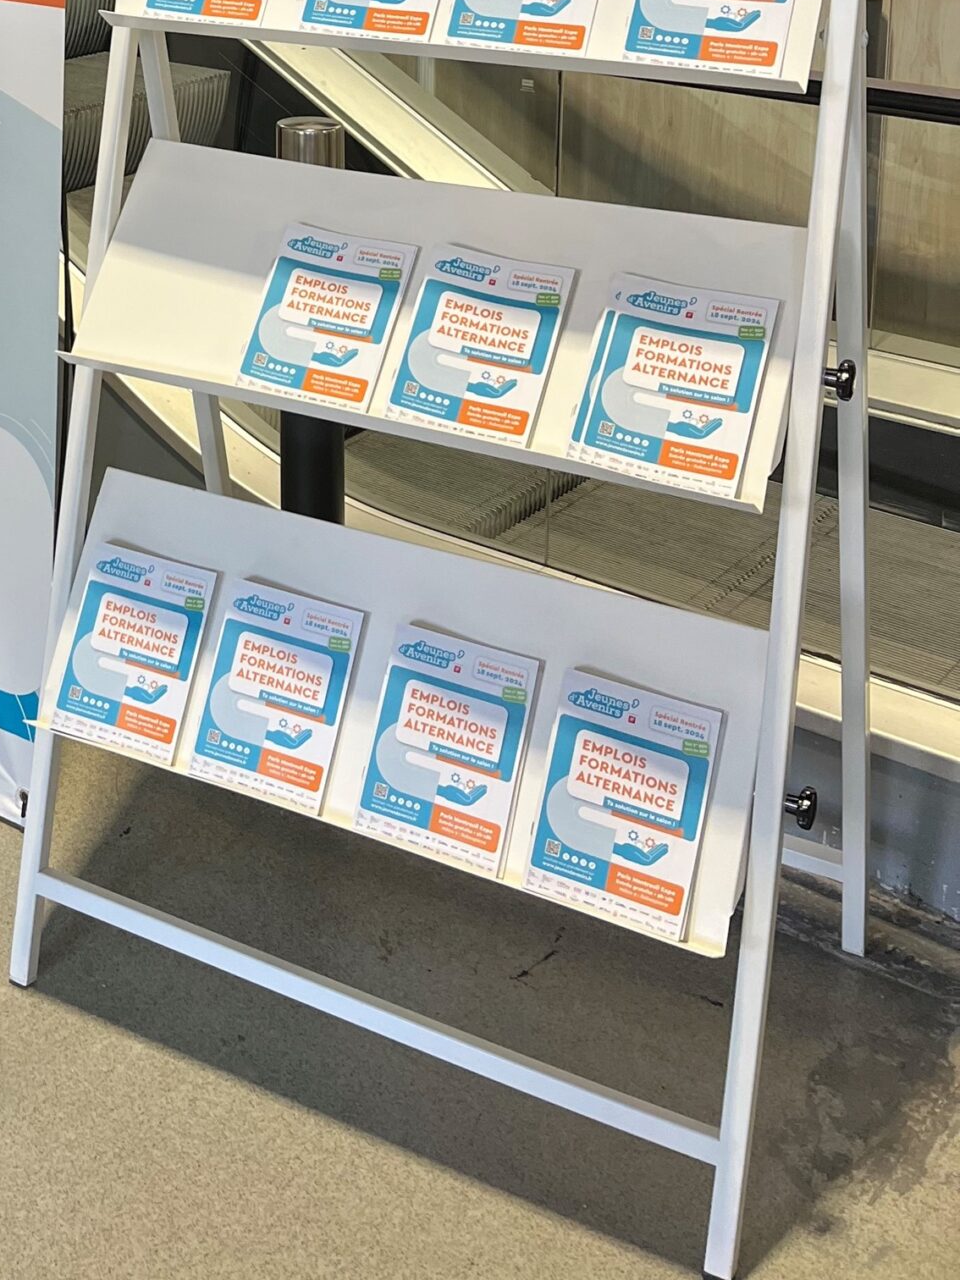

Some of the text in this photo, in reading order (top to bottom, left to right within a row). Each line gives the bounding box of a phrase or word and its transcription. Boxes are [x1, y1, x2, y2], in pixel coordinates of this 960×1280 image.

[304, 236, 339, 250] Jeunes
[453, 258, 491, 274] Jeunes
[294, 275, 348, 294] EMPLOIS
[286, 298, 367, 324] ALTERNANCE
[290, 286, 372, 312] FORMATIONS
[444, 298, 503, 321] EMPLOIS
[646, 291, 687, 307] Jeunes
[436, 323, 525, 354] ALTERNANCE
[440, 310, 529, 341] FORMATIONS
[638, 334, 703, 356] EMPLOIS
[635, 347, 733, 376] FORMATIONS
[631, 361, 729, 390] ALTERNANCE
[669, 386, 693, 395] solution
[112, 557, 146, 575] Jeunes
[104, 599, 157, 624] EMPLOIS
[250, 595, 286, 613] Jeunes
[97, 625, 176, 658] ALTERNANCE
[101, 612, 180, 645] FORMATIONS
[242, 639, 298, 665] EMPLOIS
[416, 641, 455, 660] Jeunes
[239, 652, 323, 687] FORMATIONS
[235, 666, 319, 701] ALTERNANCE
[410, 687, 470, 716] EMPLOIS
[587, 688, 630, 710] Jeunes
[407, 701, 497, 740] FORMATIONS
[403, 716, 494, 755] ALTERNANCE
[439, 746, 461, 758] solution
[581, 738, 647, 769] EMPLOIS
[578, 753, 677, 796] FORMATIONS
[575, 769, 674, 812] ALTERNANCE
[614, 801, 638, 814] solution
